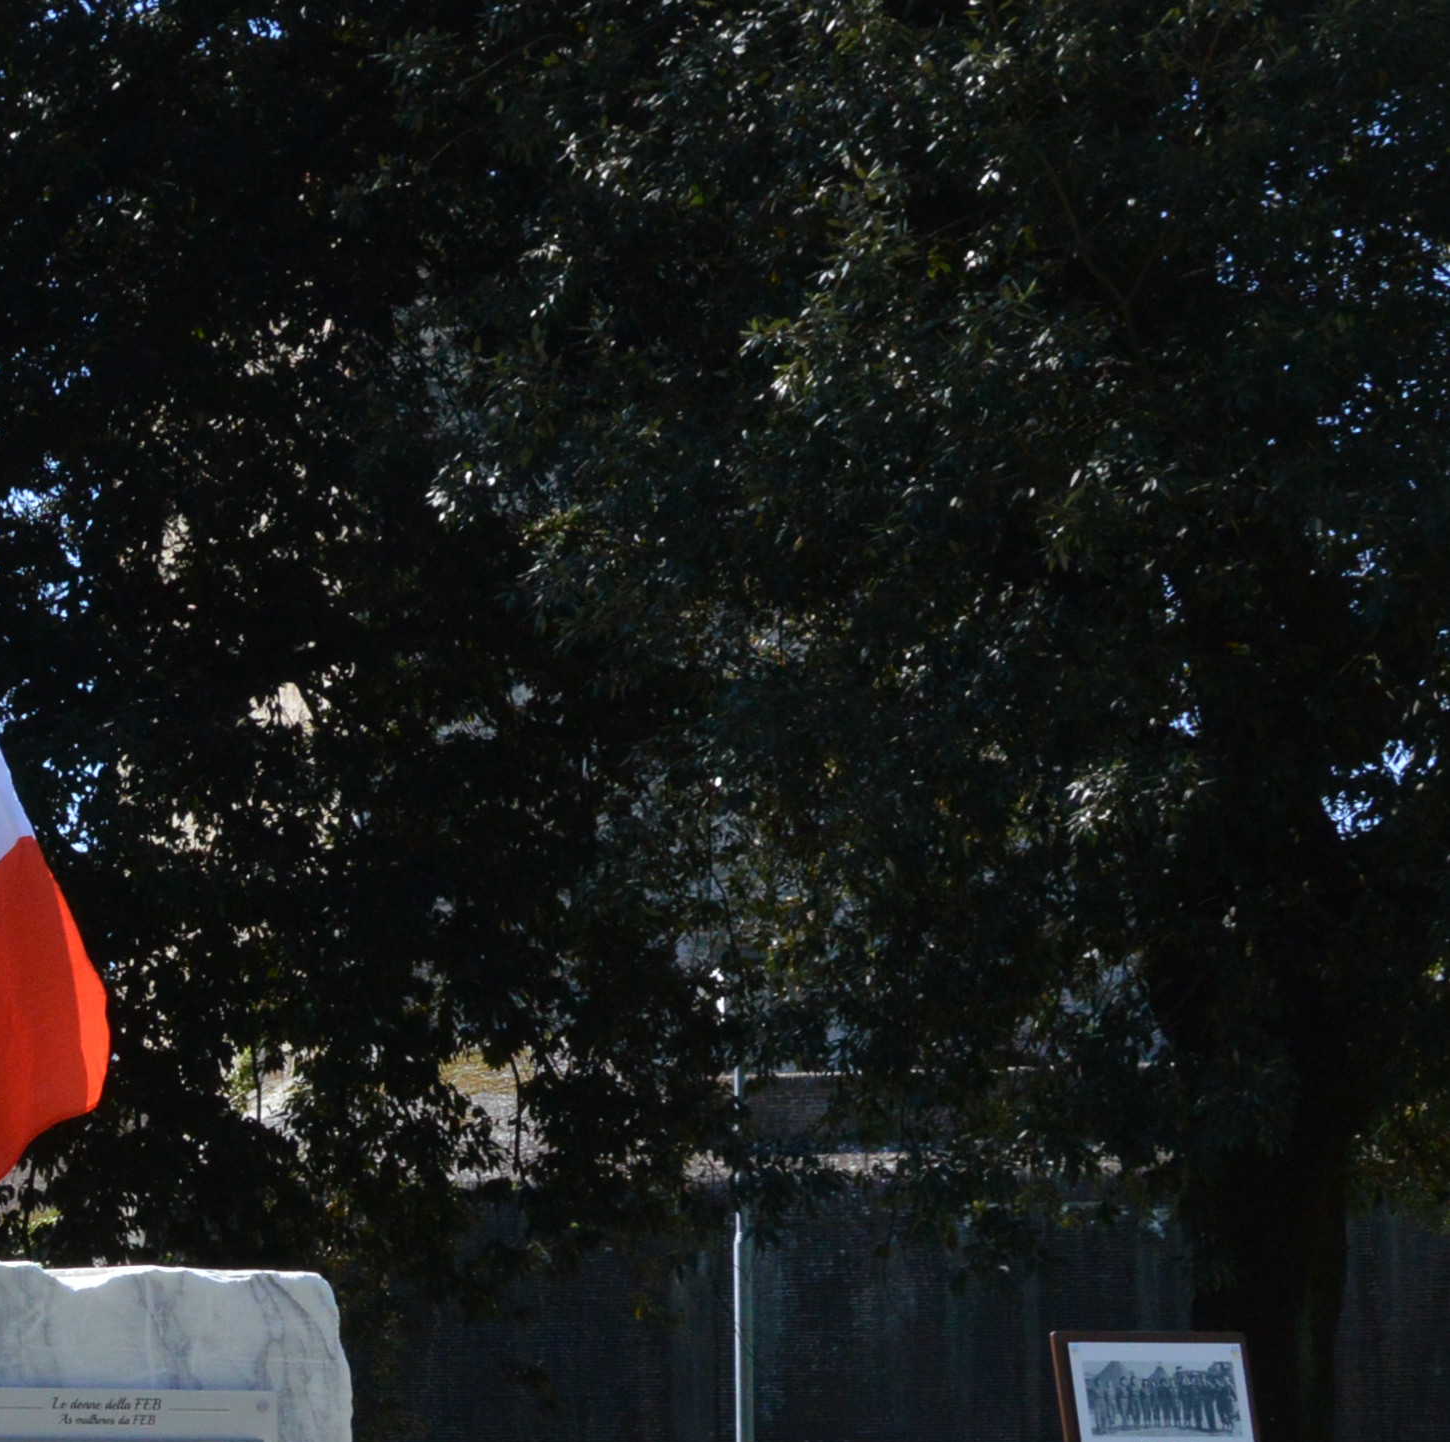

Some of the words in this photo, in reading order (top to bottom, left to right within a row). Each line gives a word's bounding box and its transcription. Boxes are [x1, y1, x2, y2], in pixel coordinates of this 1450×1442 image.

[52, 1396, 67, 1409] Le
[70, 1398, 101, 1409] donne
[105, 1397, 131, 1410] della
[134, 1398, 161, 1410] FEB
[118, 1415, 130, 1425] da
[133, 1415, 156, 1425] FEB
